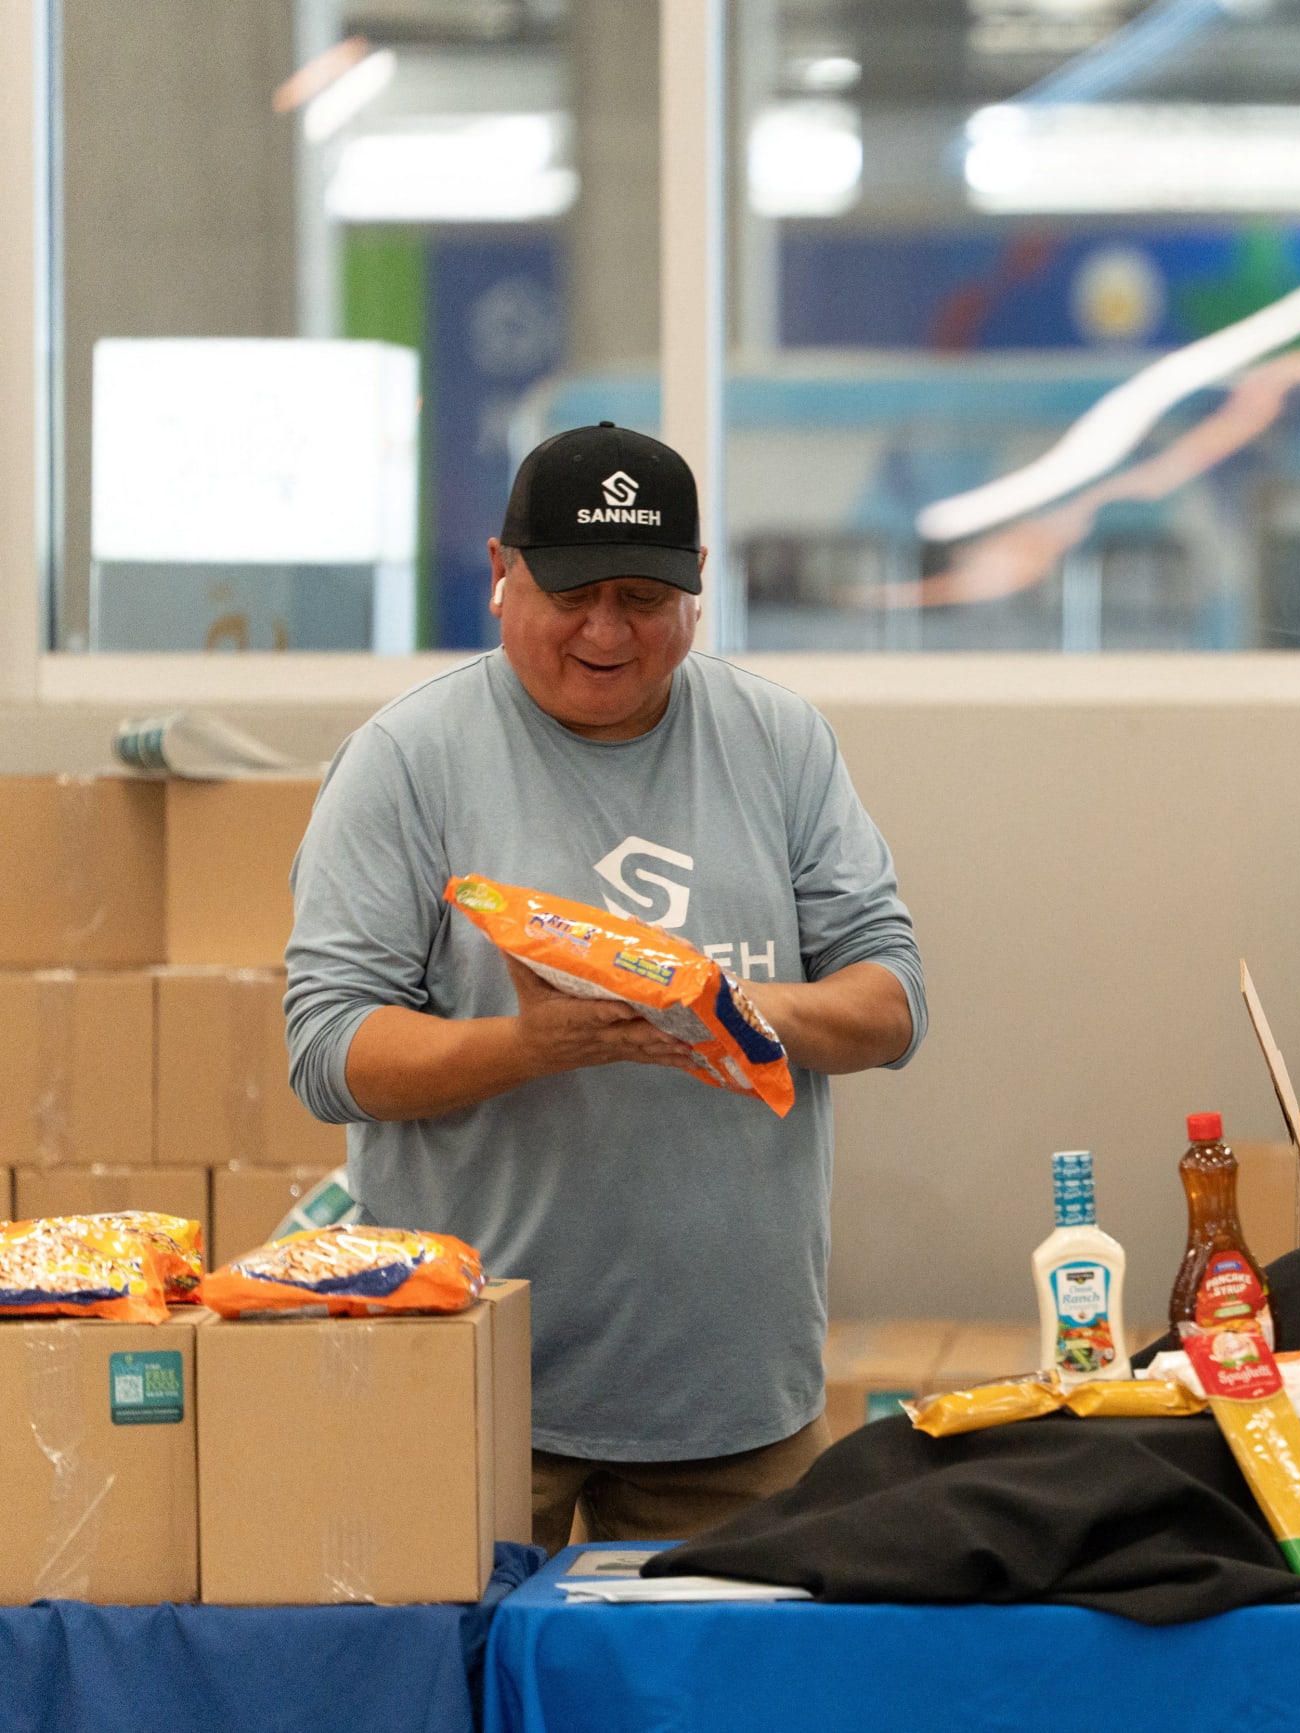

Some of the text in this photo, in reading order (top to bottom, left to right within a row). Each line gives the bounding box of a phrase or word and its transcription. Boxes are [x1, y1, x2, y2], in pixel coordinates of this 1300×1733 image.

[577, 508, 661, 526] SANNEH
[1205, 1272, 1252, 1291] PANCAKE
[1063, 1292, 1100, 1304] Ranch
[1213, 1283, 1247, 1297] SYRUP
[145, 1369, 175, 1381] FREE
[1217, 1364, 1272, 1386] Spaghetti
